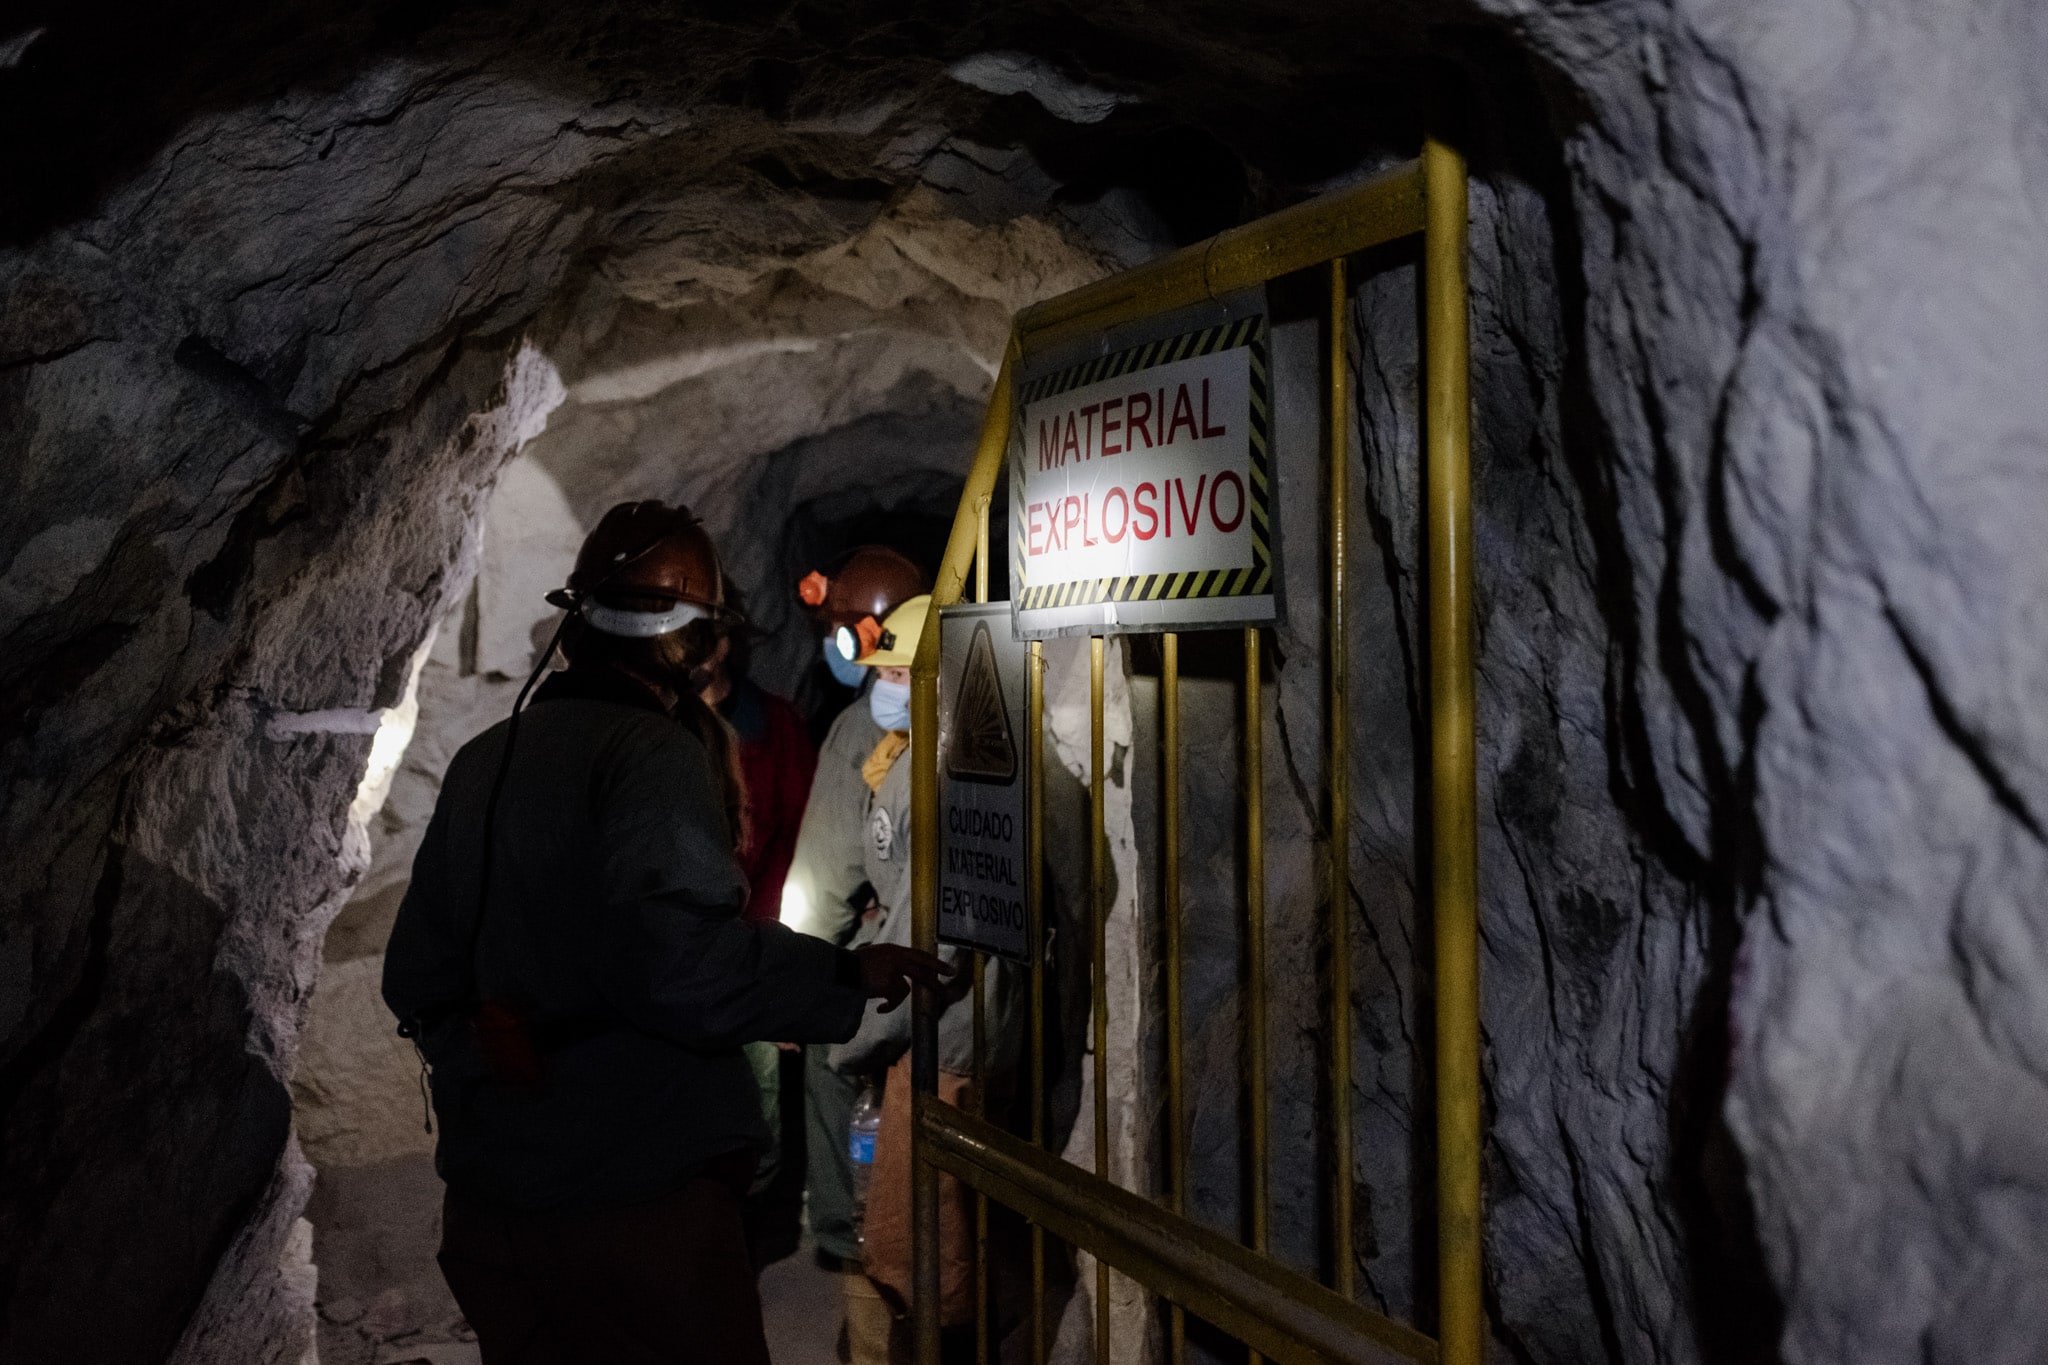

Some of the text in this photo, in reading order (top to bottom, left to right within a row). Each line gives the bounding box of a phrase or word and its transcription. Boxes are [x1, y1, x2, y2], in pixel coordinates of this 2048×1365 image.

[1038, 378, 1226, 472] MATERIAL
[1027, 469, 1245, 557] EXPLOSIVO
[950, 806, 1013, 842] CUIDADO
[949, 847, 1017, 886] MATERIAL
[942, 886, 1024, 931] EXPLOSIVO
